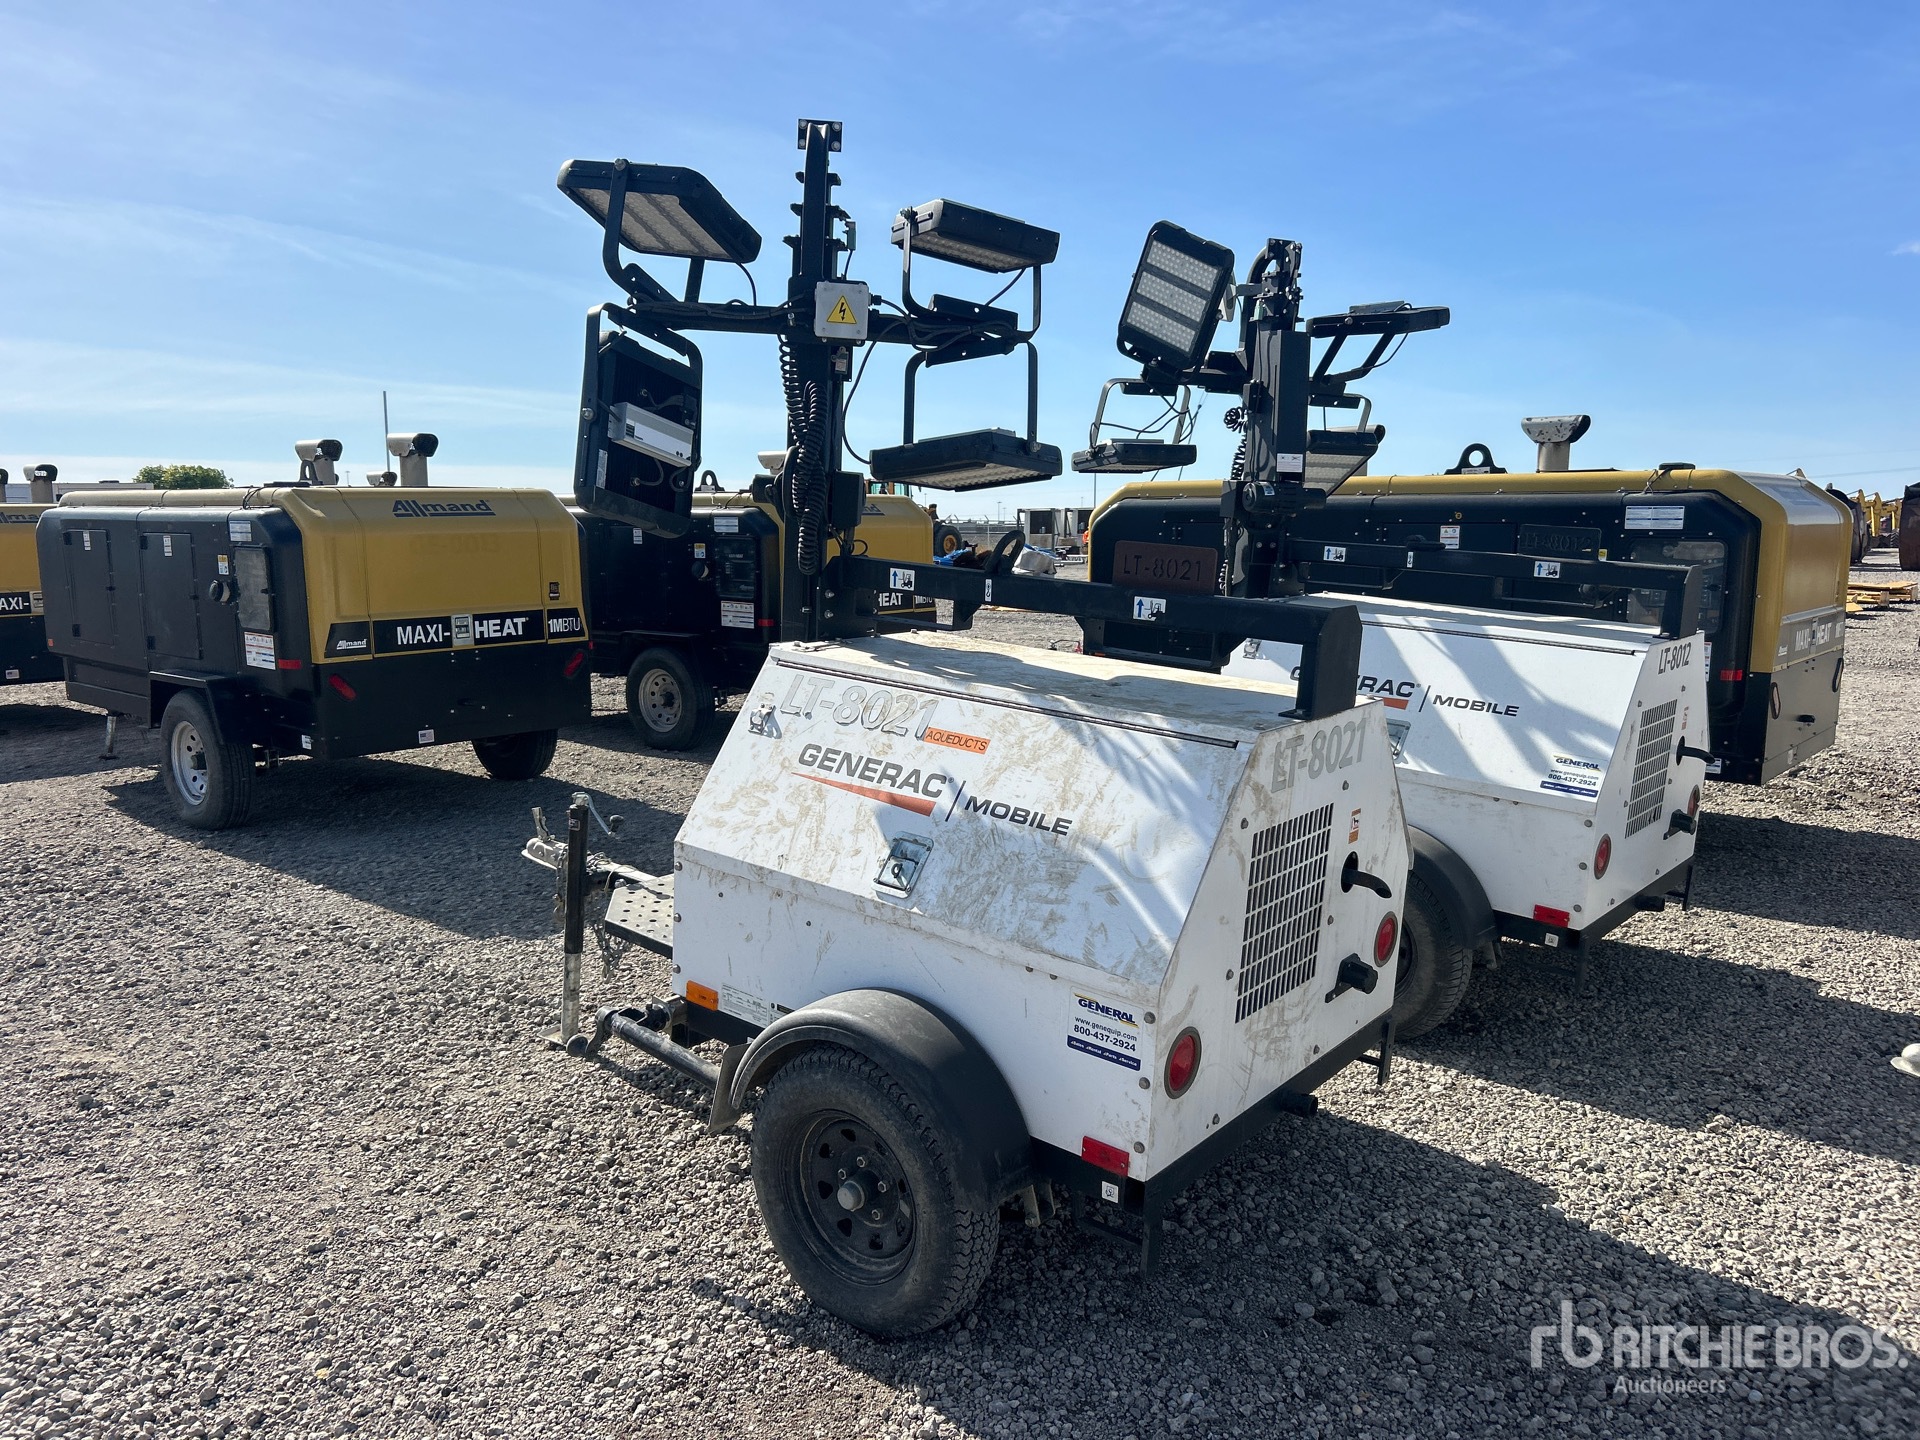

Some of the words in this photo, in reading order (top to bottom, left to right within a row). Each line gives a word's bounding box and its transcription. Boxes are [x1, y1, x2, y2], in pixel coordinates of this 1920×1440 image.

[392, 499, 496, 517] Allmand
[1123, 554, 1202, 582] LT-8021
[336, 638, 367, 650] Allmand
[396, 623, 451, 645] MAXI-
[474, 617, 526, 638] HEAT
[547, 617, 581, 633] 1MBTU
[1657, 642, 1692, 675] LT-8012
[780, 674, 939, 740] LT-8021
[1432, 694, 1519, 717] MOBILE
[925, 731, 989, 751] AQUEDUCTS
[1271, 717, 1367, 794] LT-8021
[1555, 757, 1600, 771] GENERAL
[799, 743, 946, 798] GENERAC
[964, 795, 1073, 836] MOBILE
[1547, 773, 1597, 787] 800-437-2924
[1078, 998, 1136, 1024] GENERAL
[1073, 1024, 1136, 1052] 800-437-2924
[1075, 1016, 1138, 1042] www.genequip.com
